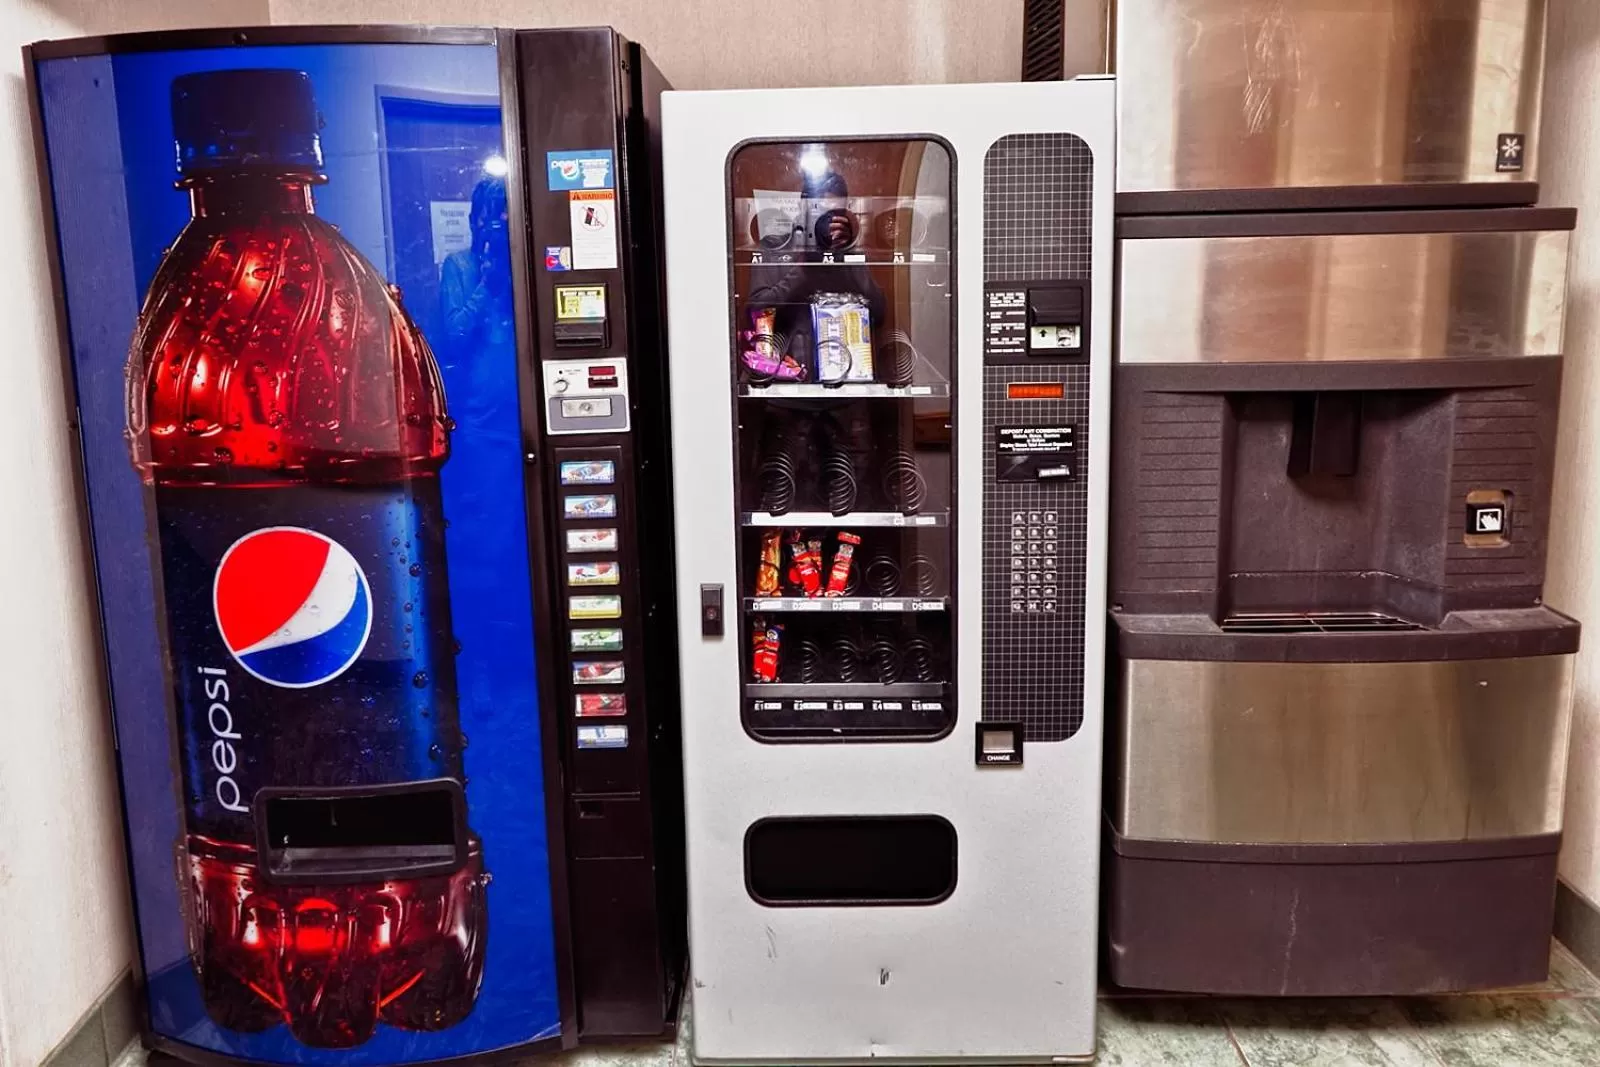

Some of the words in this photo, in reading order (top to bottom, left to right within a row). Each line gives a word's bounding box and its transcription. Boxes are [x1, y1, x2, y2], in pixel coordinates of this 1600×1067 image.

[752, 256, 763, 264] A1
[823, 256, 834, 264] A2
[893, 255, 905, 264] A3
[197, 666, 249, 813] pepsi
